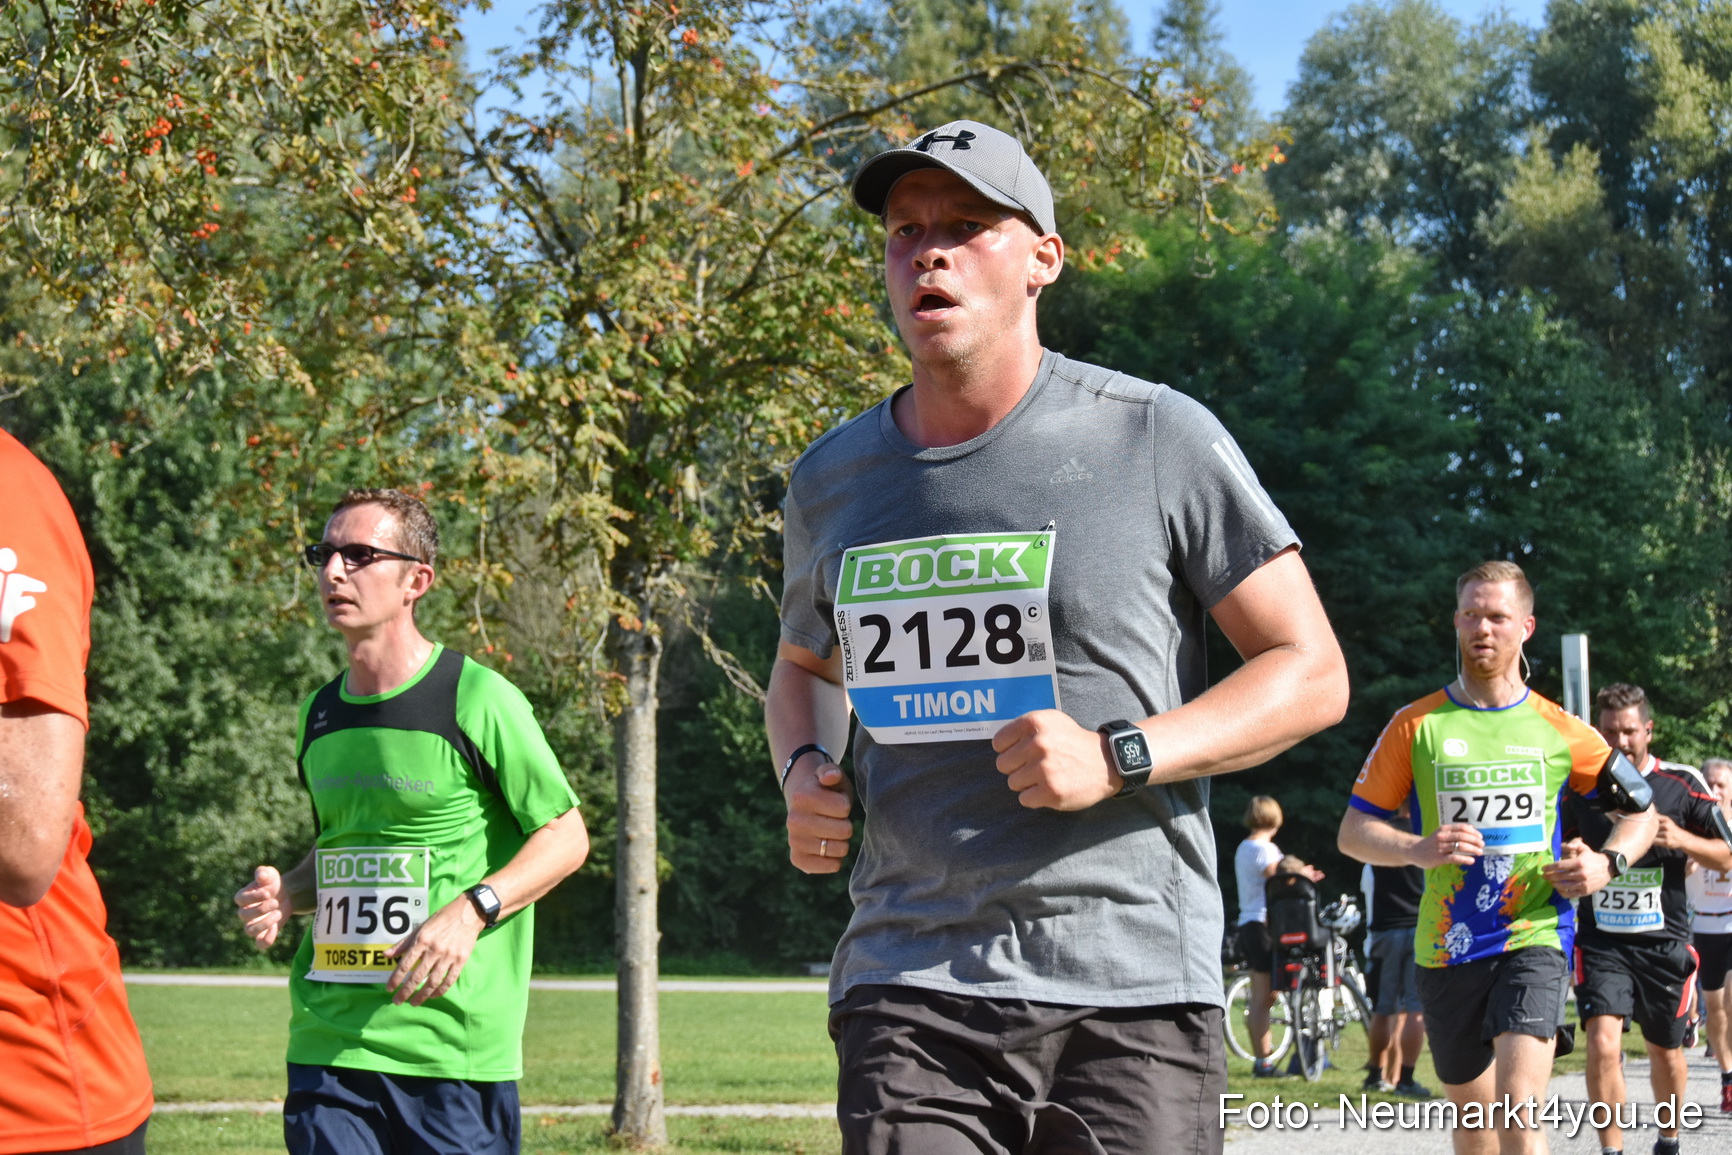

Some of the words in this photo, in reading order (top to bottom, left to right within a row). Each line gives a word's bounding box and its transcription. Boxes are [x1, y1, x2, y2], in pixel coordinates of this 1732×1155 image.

[853, 542, 1030, 596] BOCK
[1028, 607, 1037, 617] C
[859, 604, 1025, 674] 2128
[893, 688, 996, 719] TIMON
[1444, 764, 1535, 788] BOCK
[1450, 793, 1533, 823] 2729
[323, 854, 414, 884] BOCK
[1599, 890, 1653, 910] 2521
[326, 896, 410, 935] 1156
